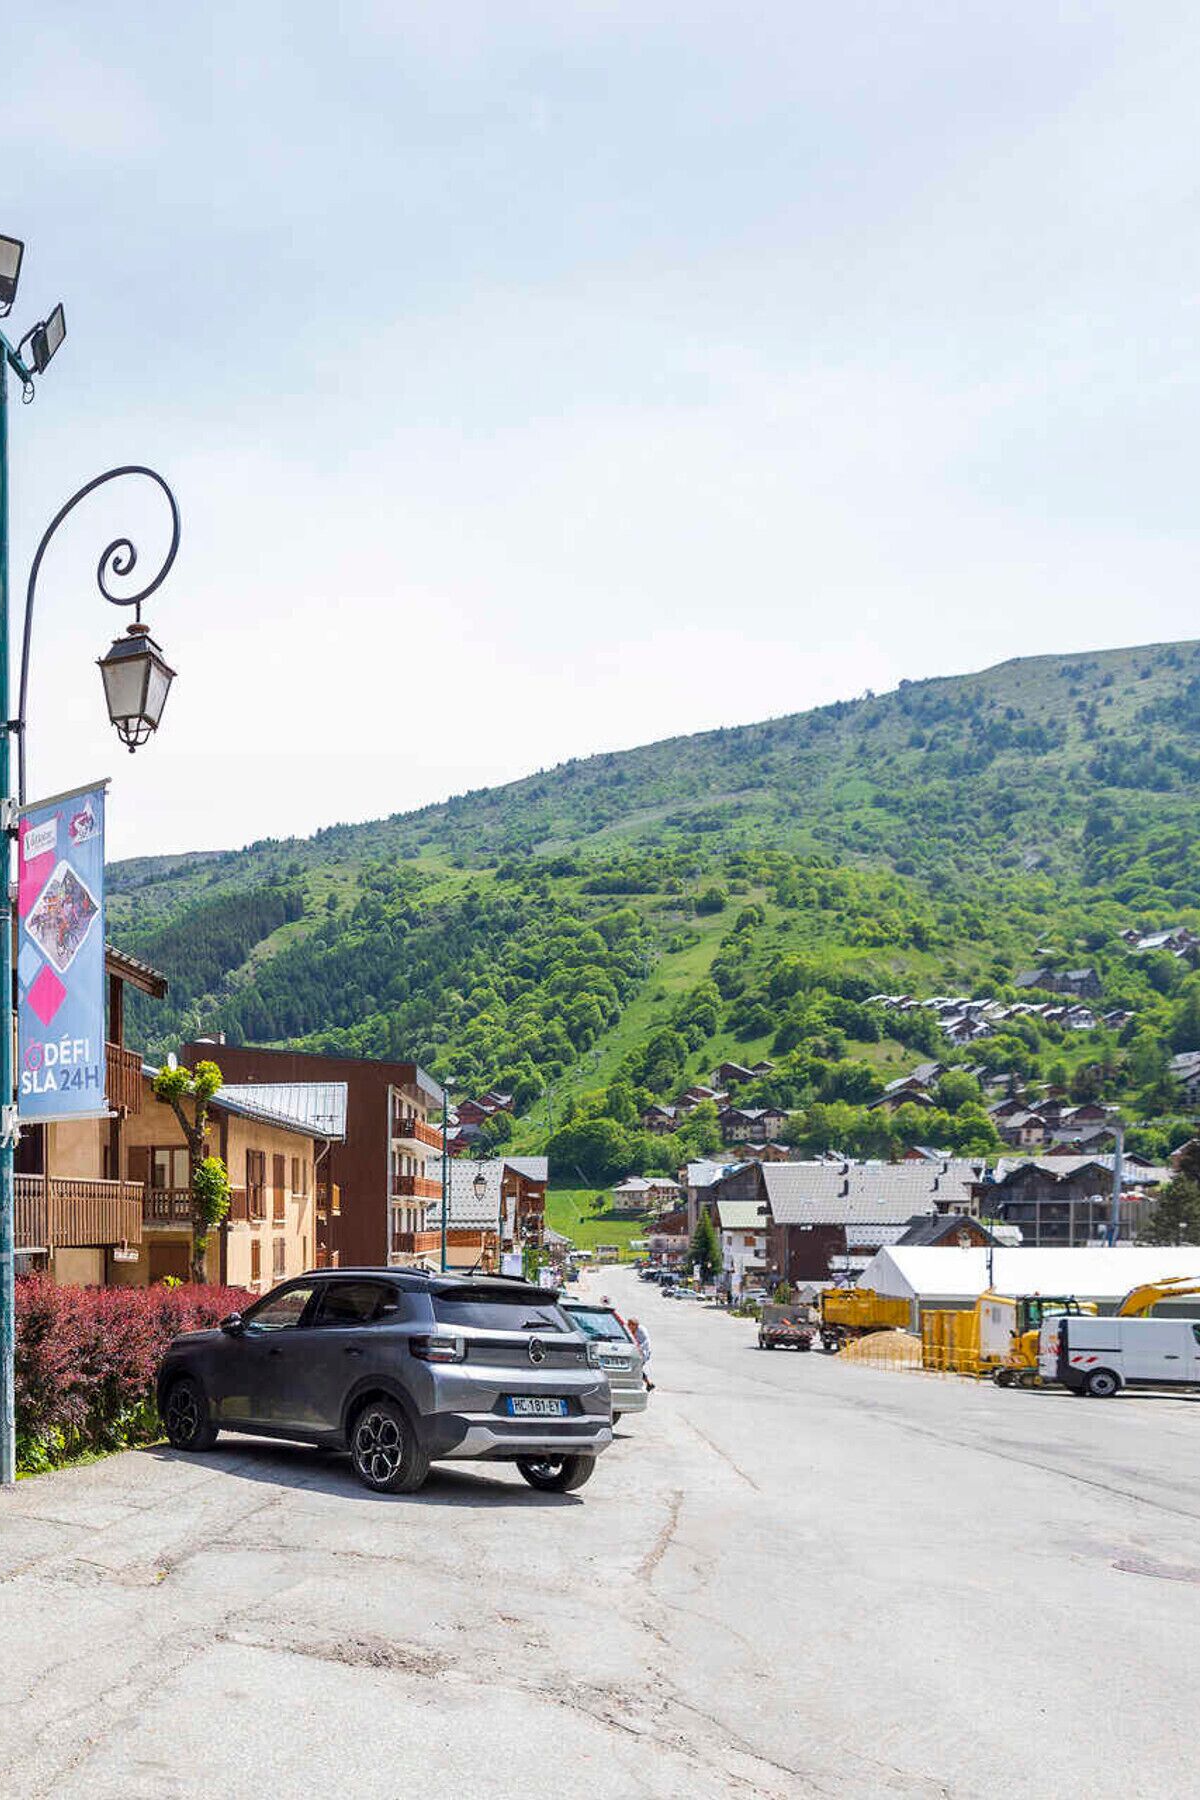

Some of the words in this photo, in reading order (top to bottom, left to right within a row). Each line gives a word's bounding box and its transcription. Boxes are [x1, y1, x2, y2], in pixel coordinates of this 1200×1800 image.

[44, 1033, 89, 1067] DÉFI
[21, 1070, 58, 1095] SLA
[60, 1065, 99, 1091] 24H
